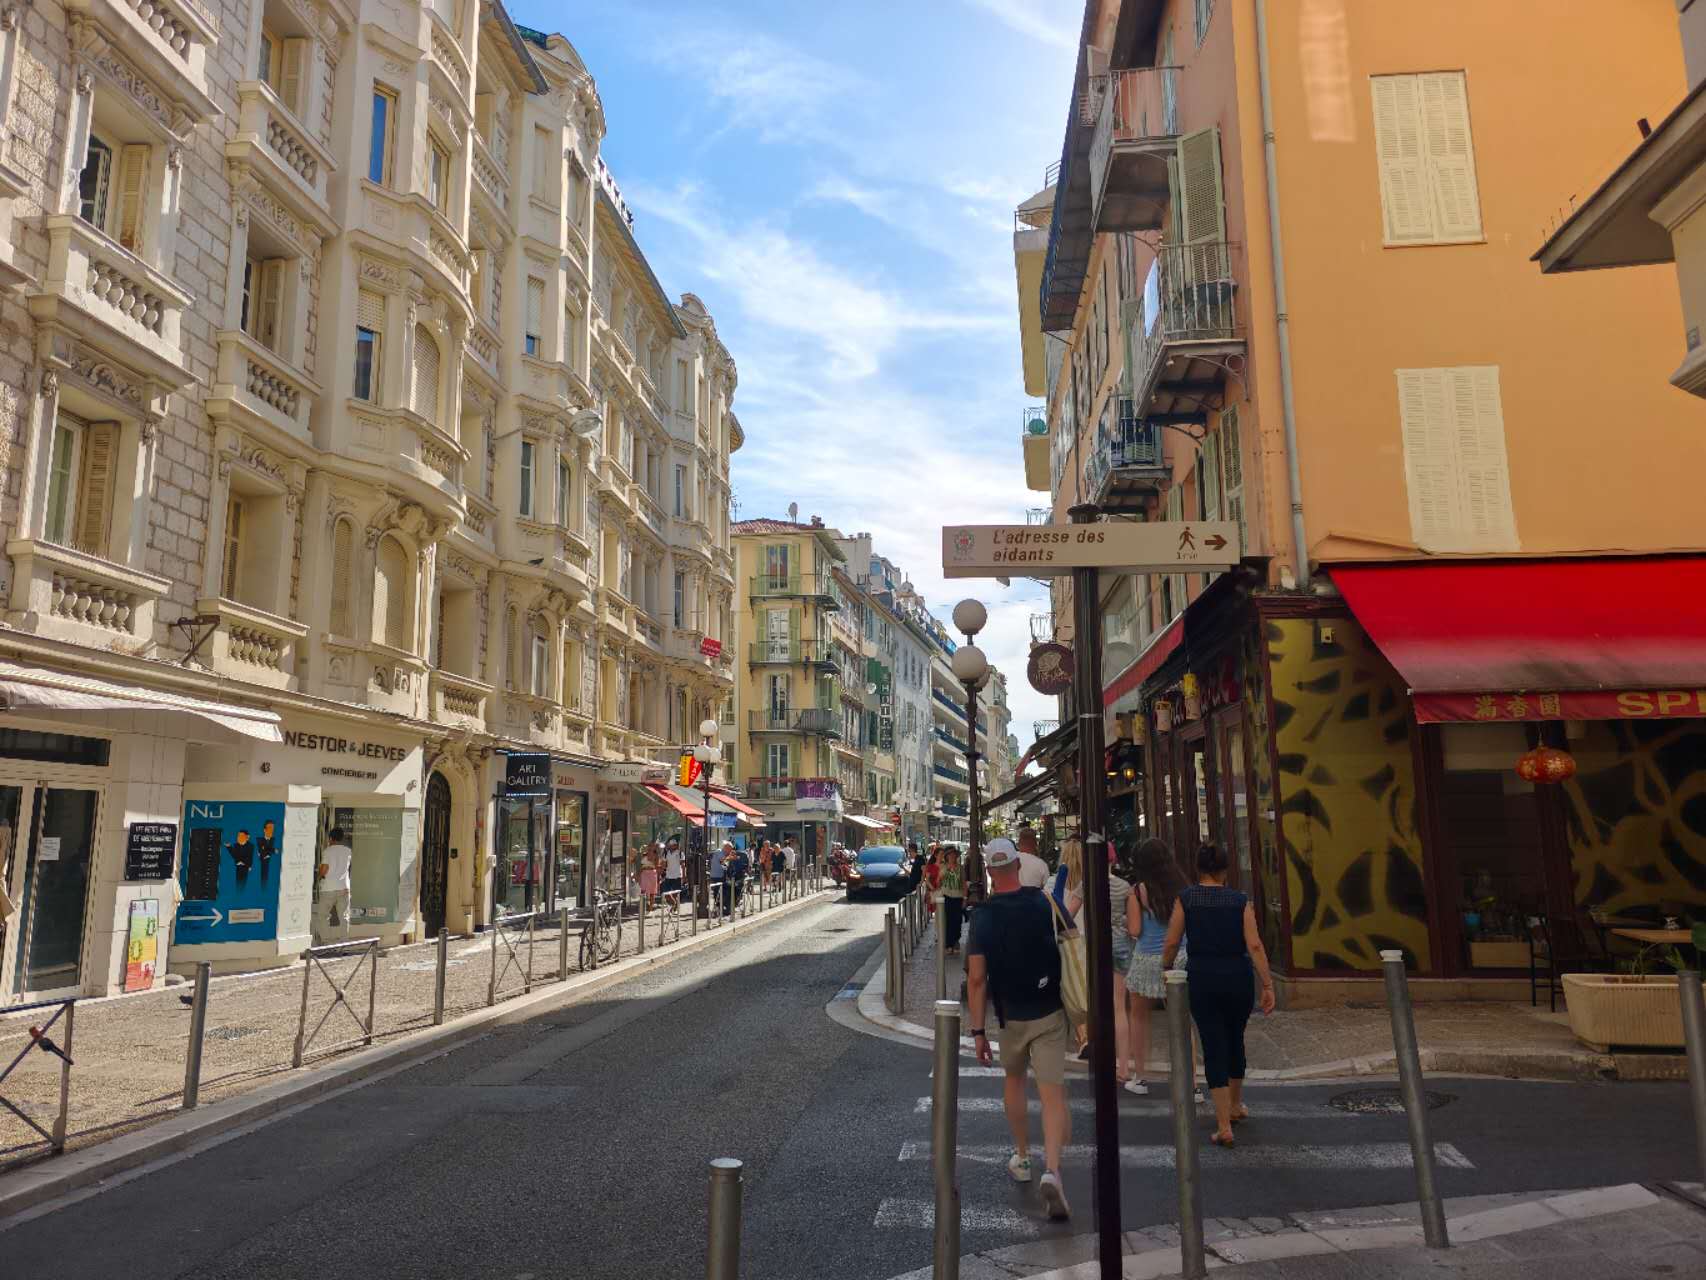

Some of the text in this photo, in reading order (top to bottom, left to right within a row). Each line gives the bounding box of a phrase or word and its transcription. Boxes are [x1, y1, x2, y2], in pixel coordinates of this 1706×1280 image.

[993, 529, 1105, 545] L'adresse des
[993, 547, 1054, 562] aidants
[284, 730, 406, 762] NESTOR & JEEVES
[518, 764, 537, 774] ART
[507, 775, 547, 786] GALLERY
[190, 803, 225, 818] NJ
